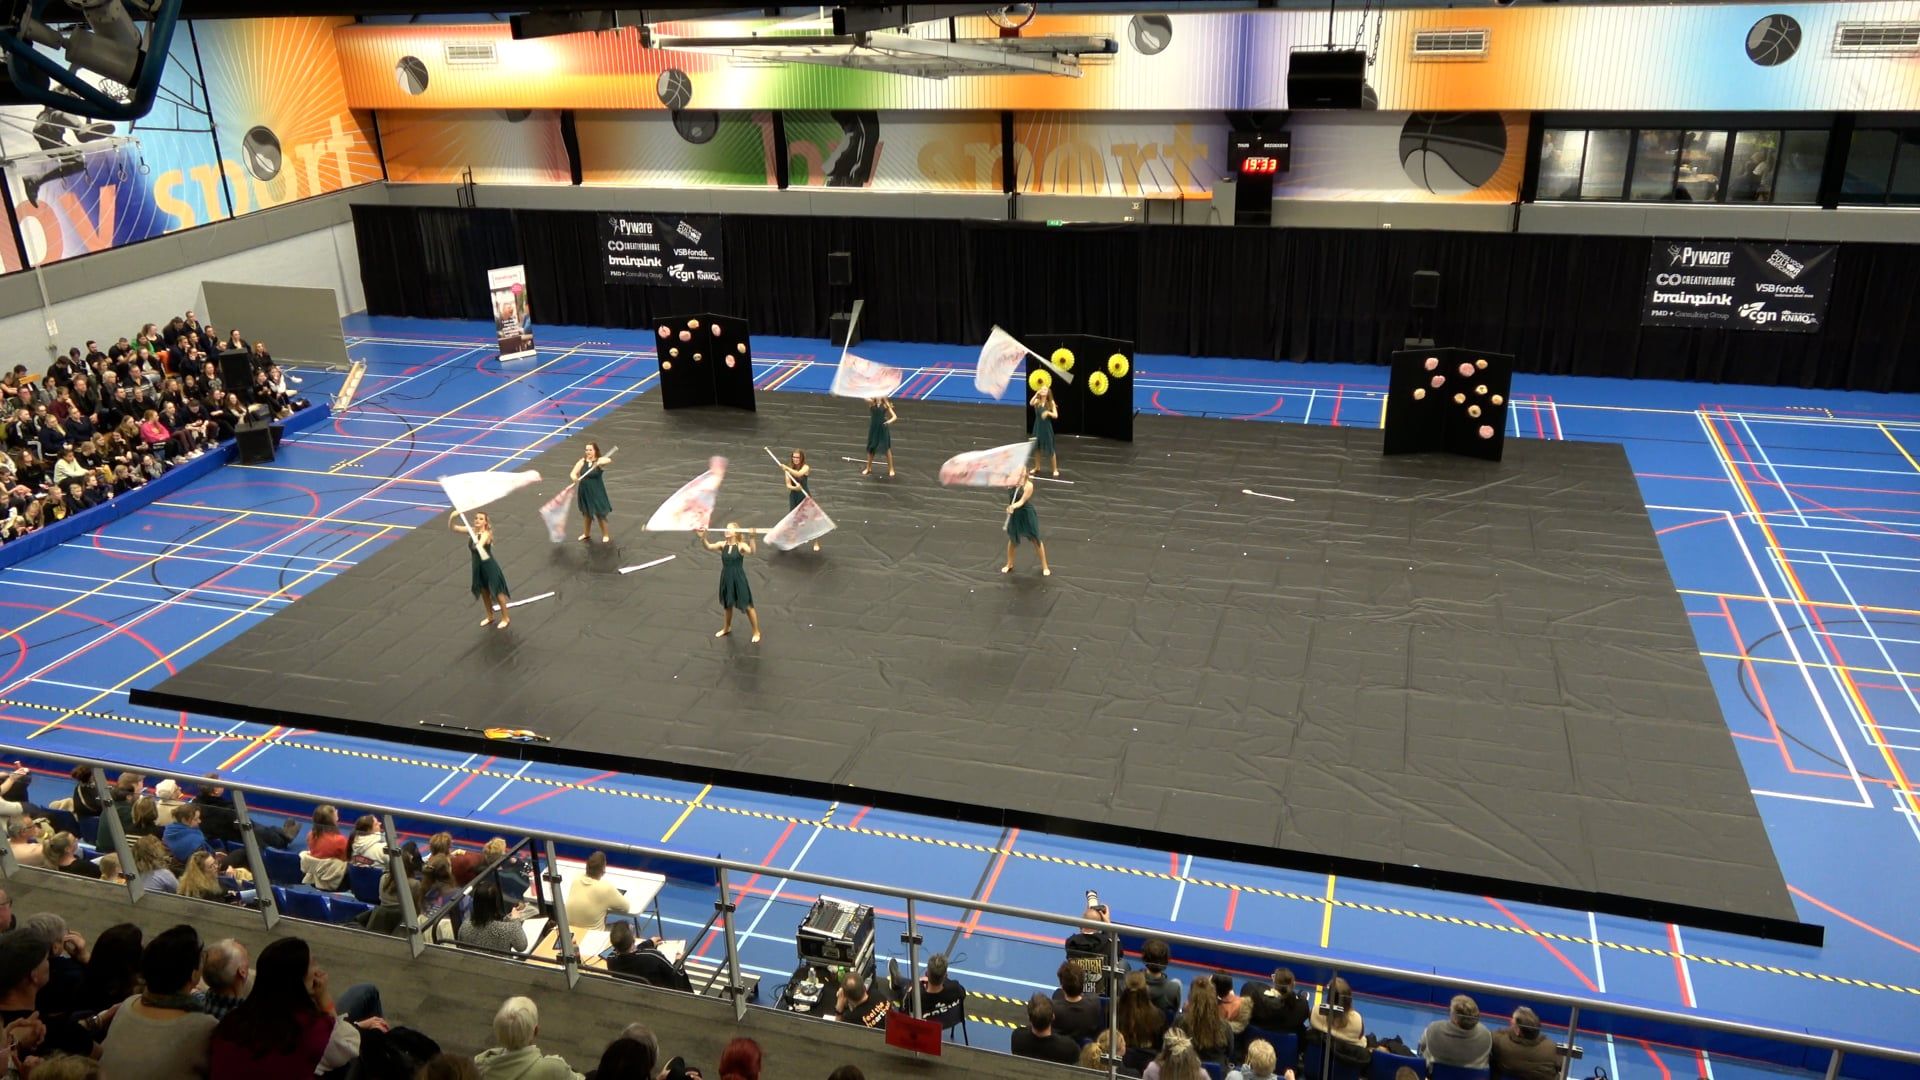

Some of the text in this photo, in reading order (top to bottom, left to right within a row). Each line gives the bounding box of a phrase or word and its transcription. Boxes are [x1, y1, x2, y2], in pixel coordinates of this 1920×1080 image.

[1243, 157, 1277, 171] 19:33
[619, 219, 653, 235] Pyware
[608, 254, 662, 267] brainpink
[1682, 247, 1731, 267] Pyware
[675, 271, 695, 282] cgn
[1652, 290, 1733, 307] brainpink
[1749, 311, 1777, 324] cgn
